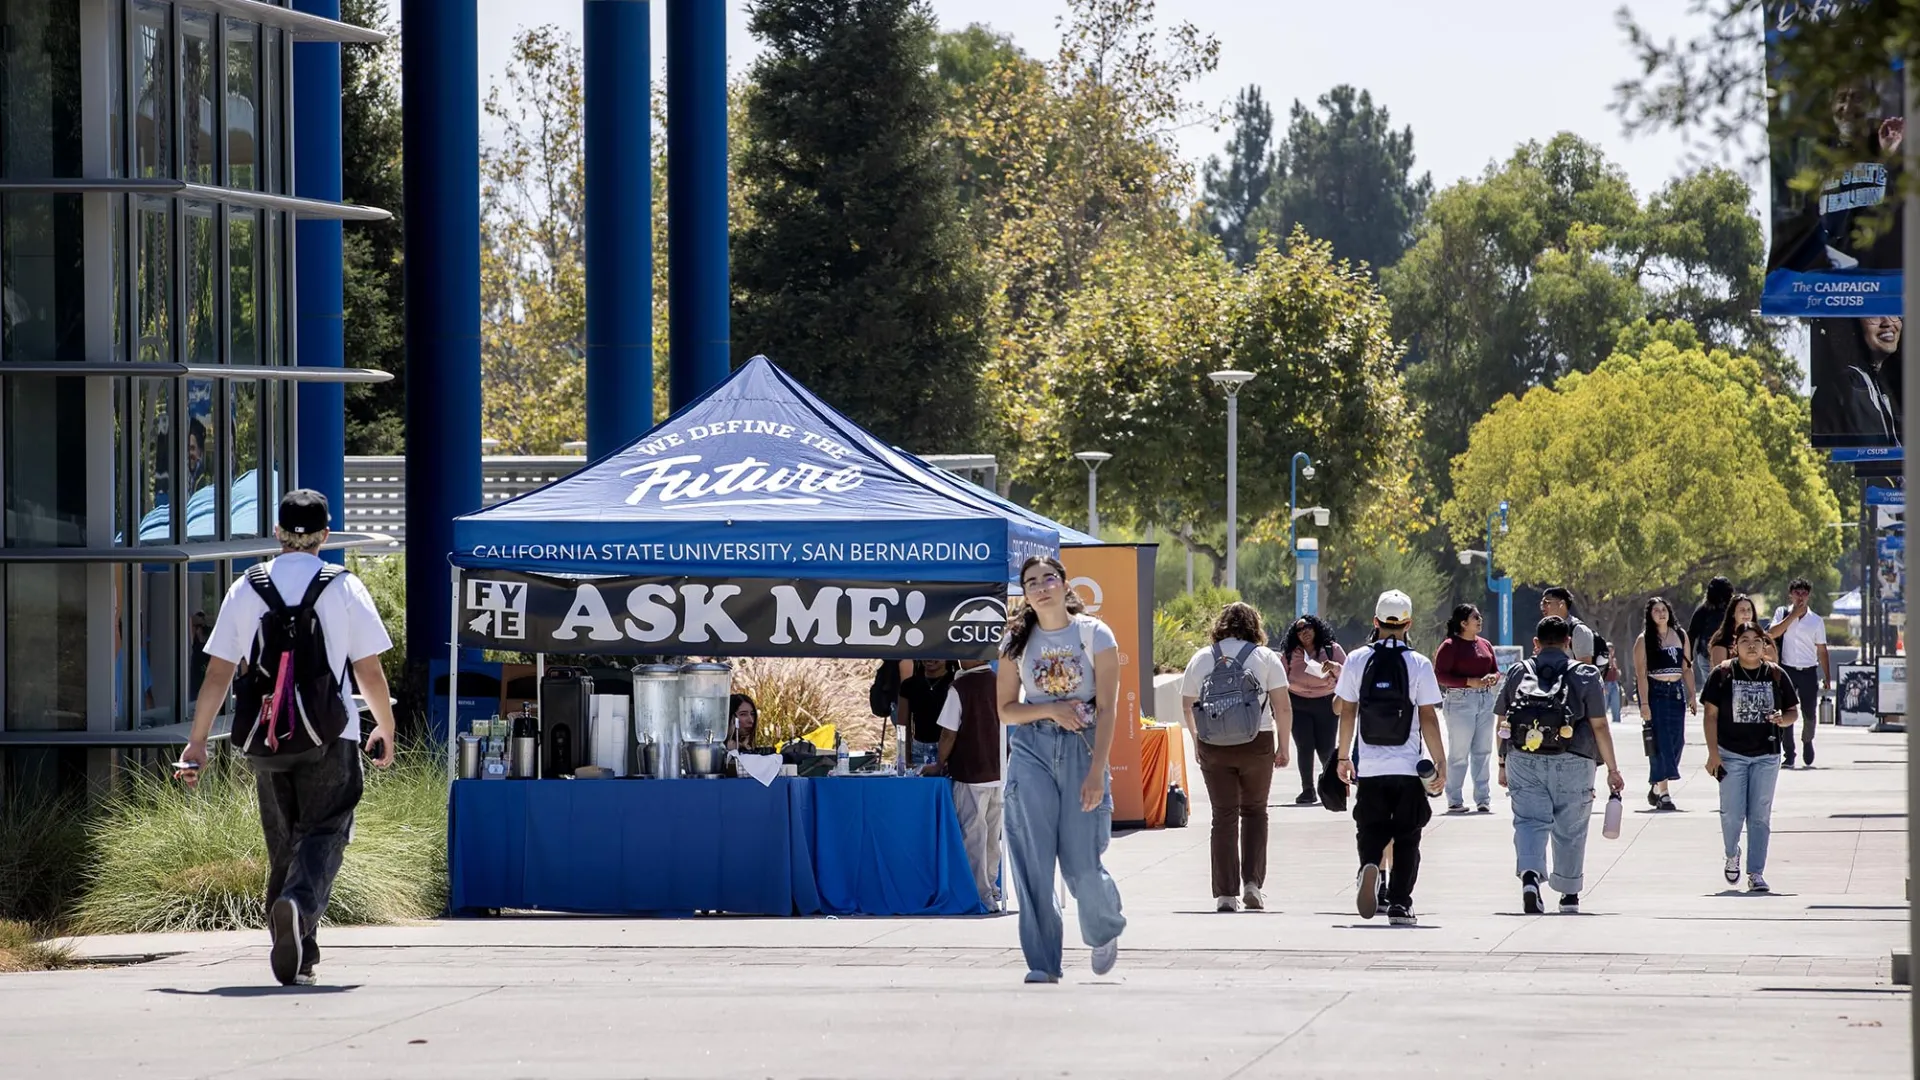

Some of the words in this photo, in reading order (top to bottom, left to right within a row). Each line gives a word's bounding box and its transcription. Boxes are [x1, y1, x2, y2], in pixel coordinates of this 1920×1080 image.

[1793, 282, 1813, 292] The
[1814, 282, 1880, 292] CAMPAIGN
[1805, 296, 1822, 309] for
[1825, 296, 1864, 306] CSUSB
[638, 433, 684, 457] WE
[689, 420, 796, 441] DEFINE
[800, 430, 852, 460] THE
[620, 455, 864, 508] Future
[472, 544, 598, 560] CALIFORNIA
[601, 543, 665, 560] STATE
[669, 542, 797, 563] UNIVERSITY,
[801, 543, 844, 561] SAN
[851, 543, 991, 561] BERNARDINO
[1301, 583, 1310, 616] Emerg
[551, 583, 748, 642] ASK
[769, 585, 926, 647] ME!
[947, 625, 1005, 643] CSUS
